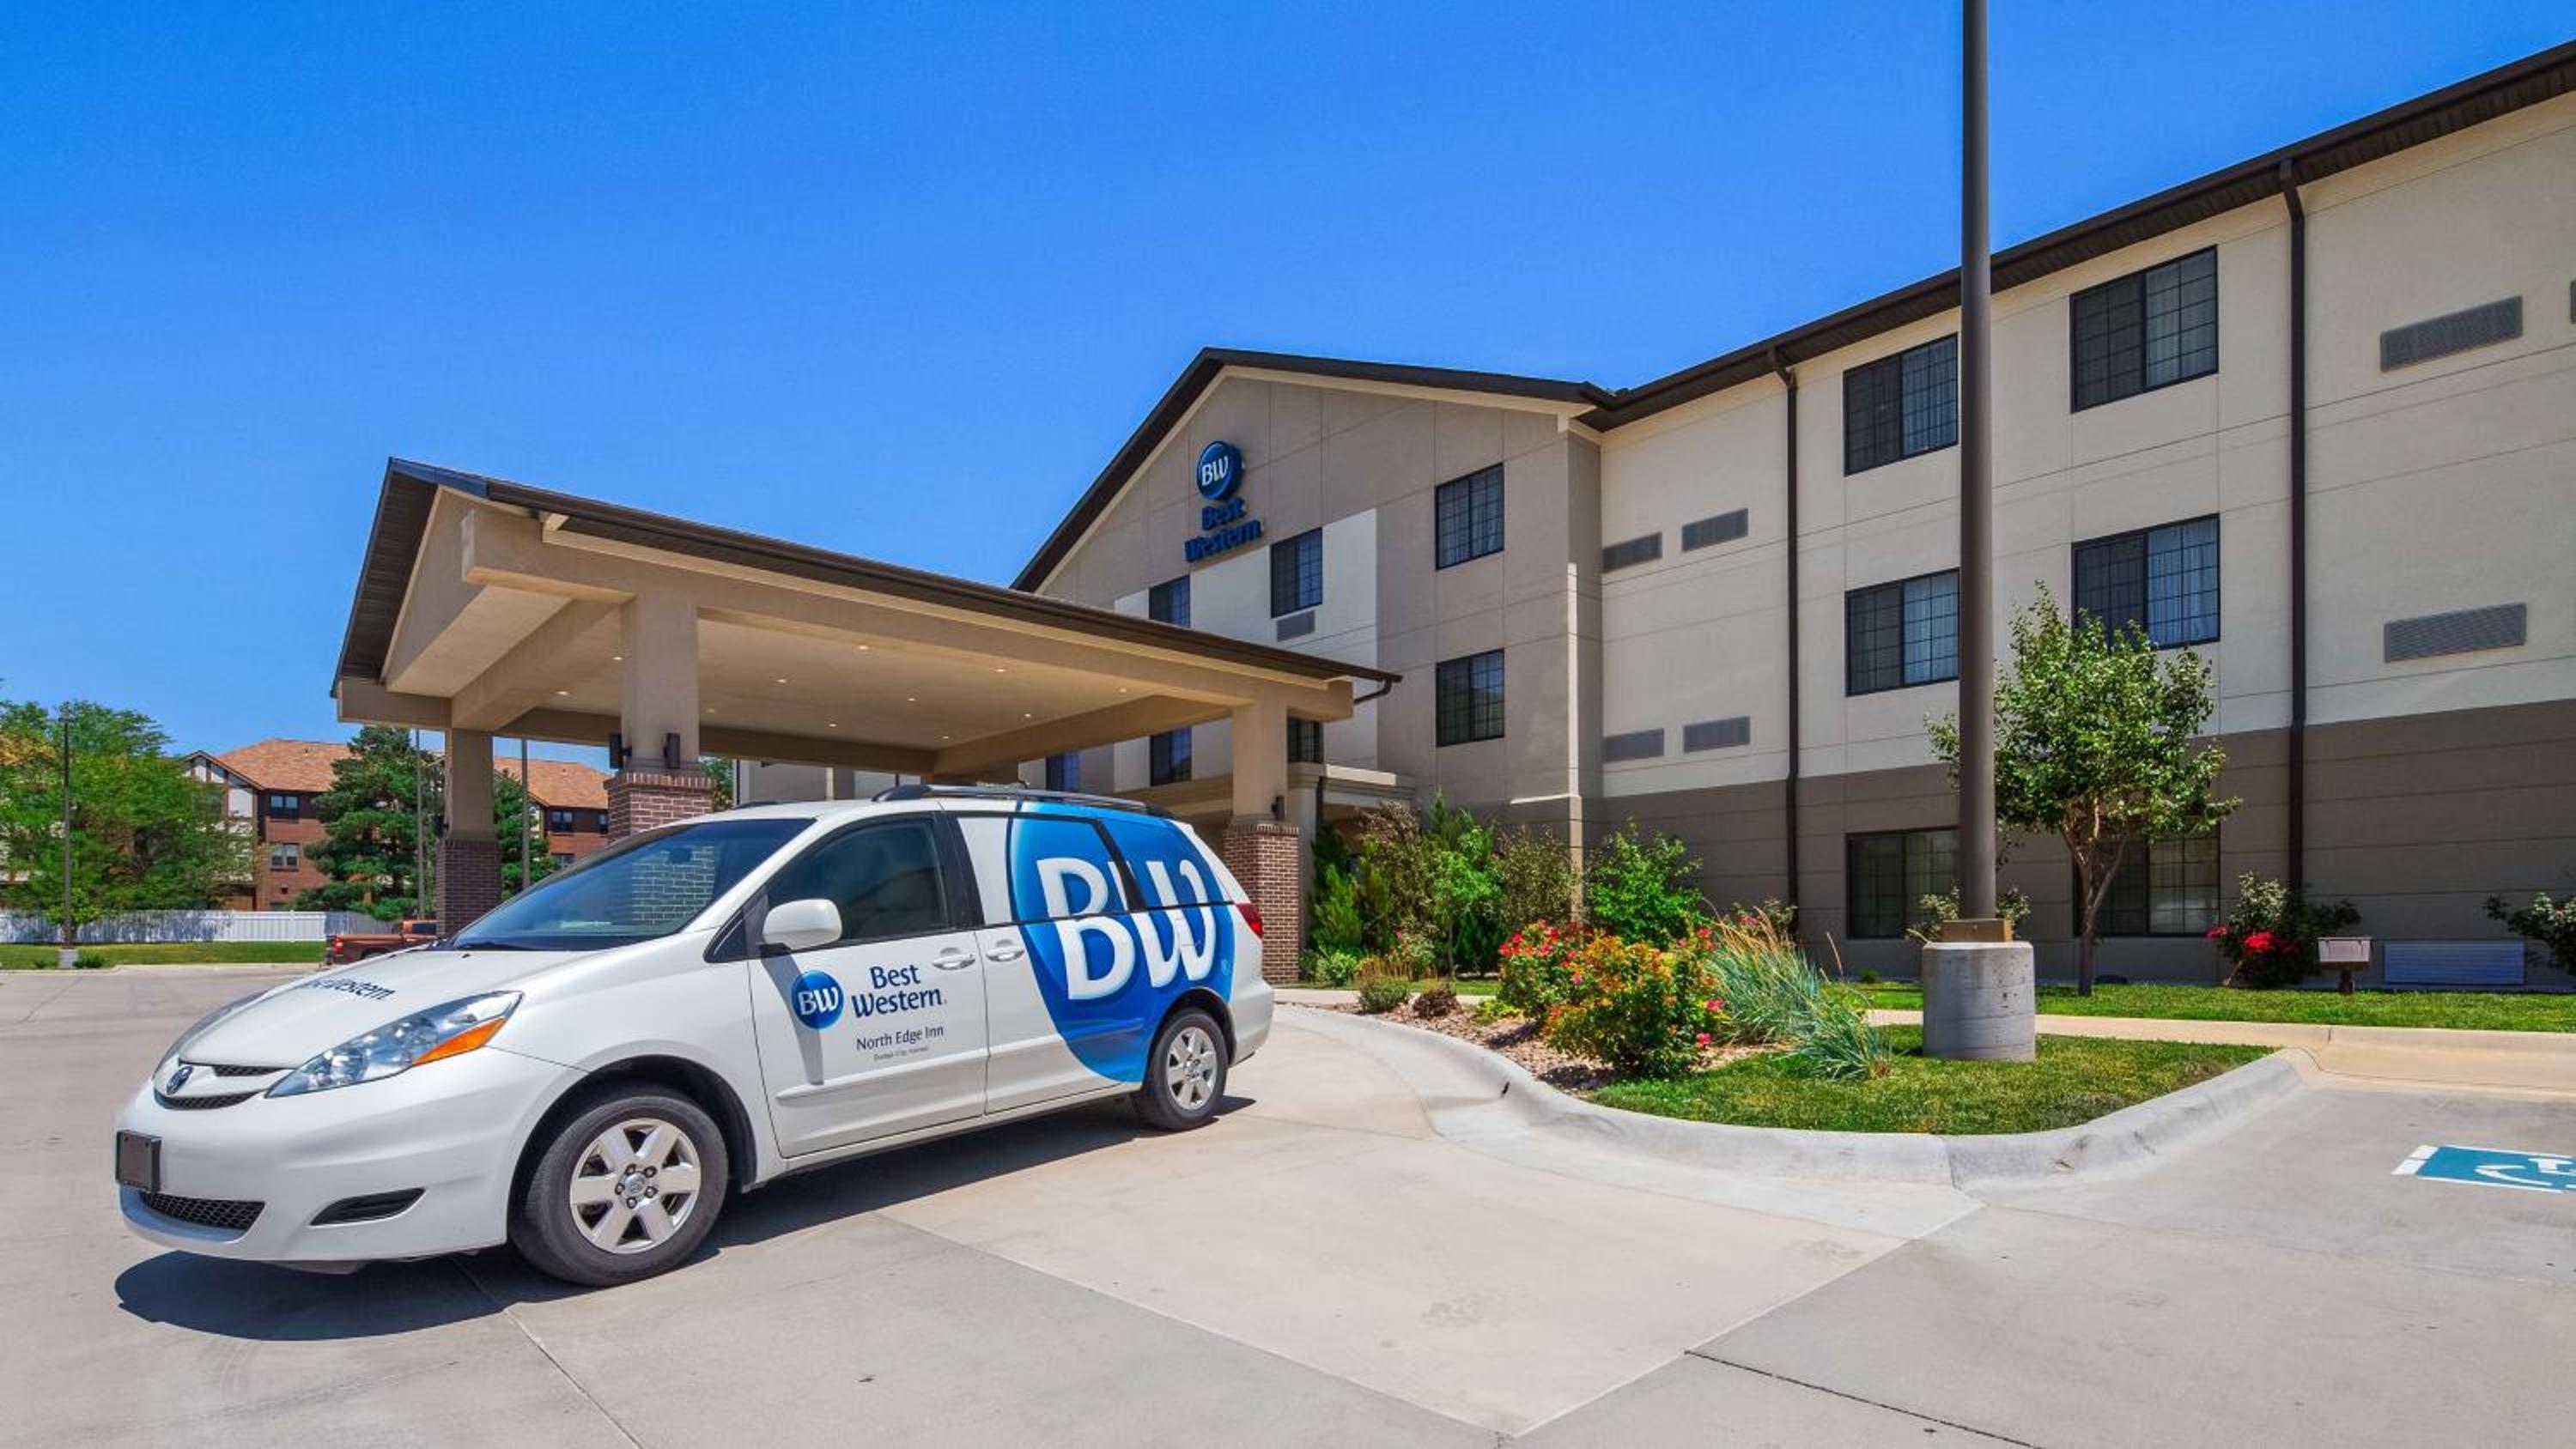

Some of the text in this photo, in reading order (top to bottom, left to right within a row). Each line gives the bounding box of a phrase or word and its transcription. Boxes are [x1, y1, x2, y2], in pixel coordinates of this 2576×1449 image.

[1202, 456, 1229, 486] BW
[1036, 857, 1217, 1000] BW
[870, 964, 920, 989] Best
[798, 986, 839, 1016] BW
[852, 988, 943, 1018] Western
[856, 1026, 944, 1051] North Edge Inn
